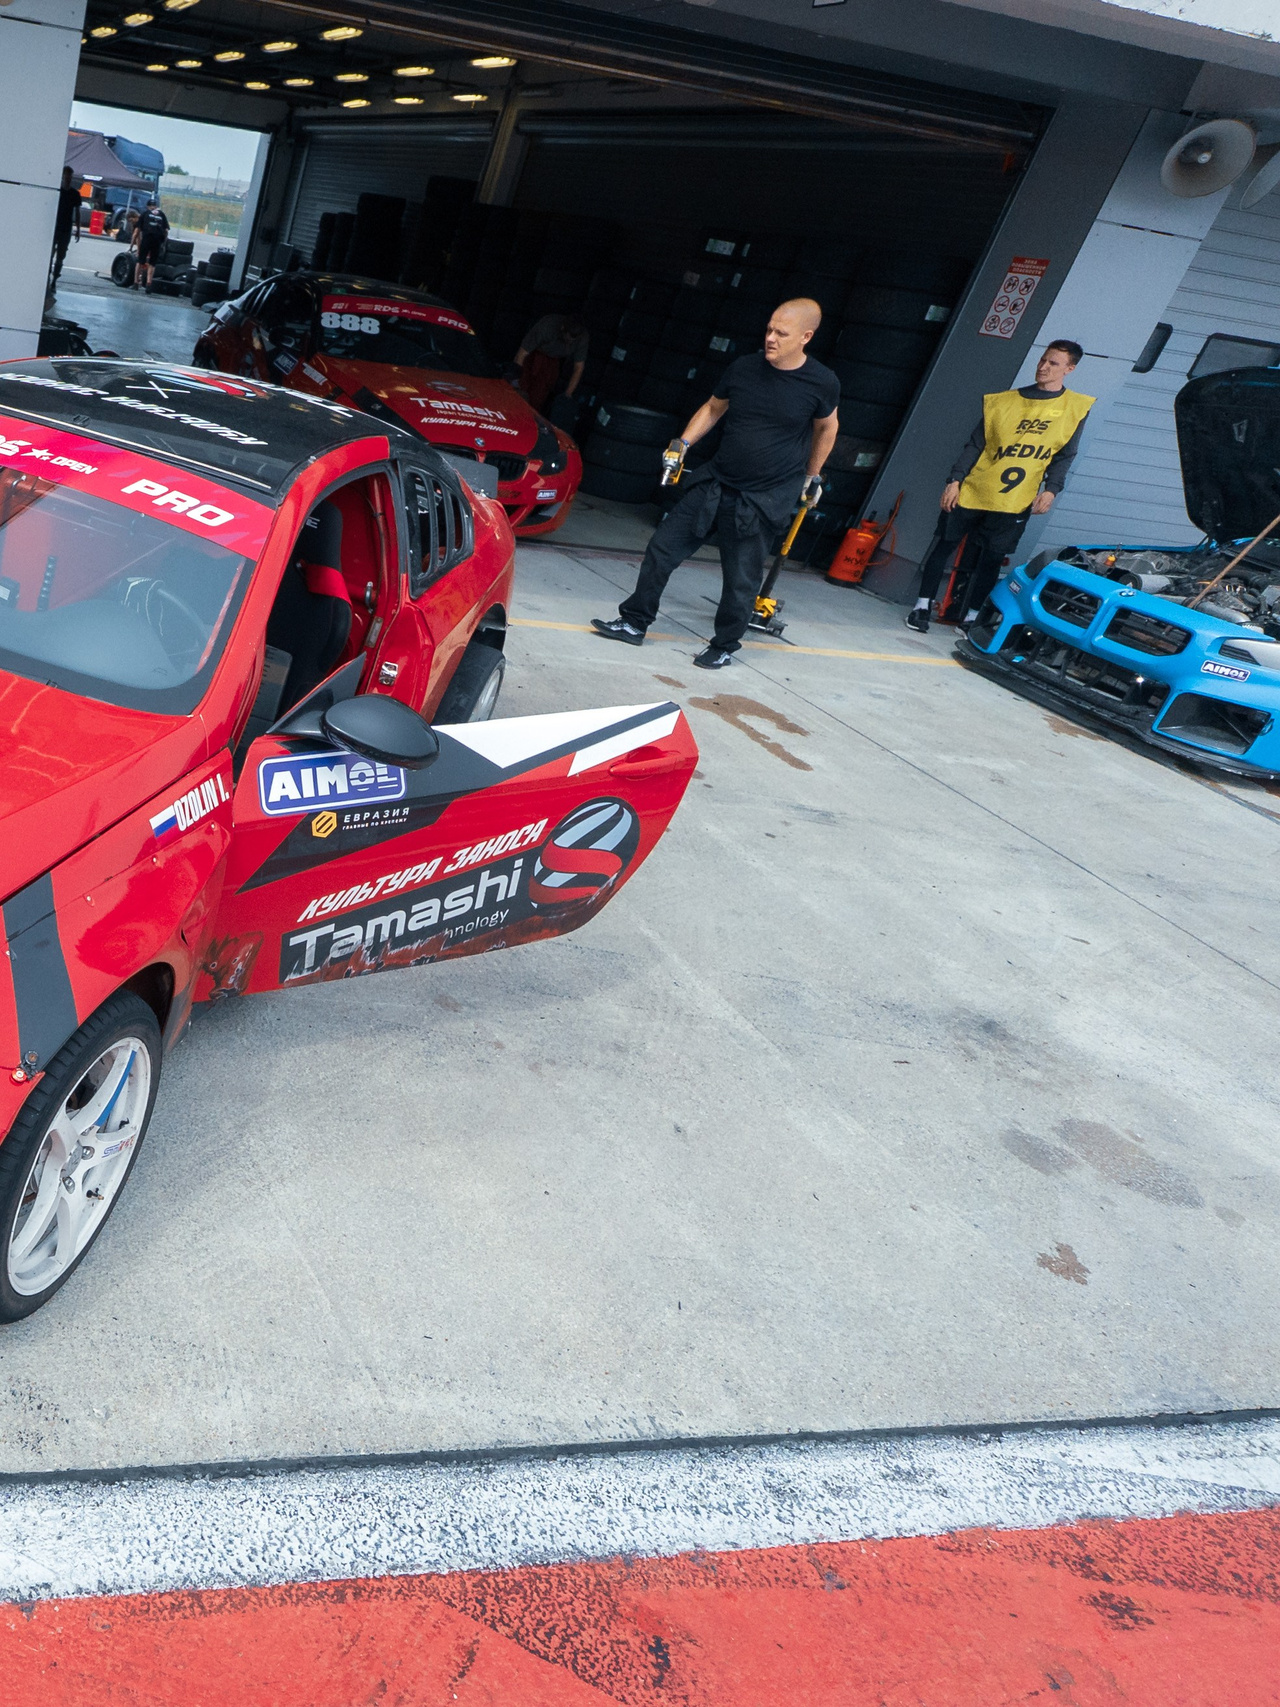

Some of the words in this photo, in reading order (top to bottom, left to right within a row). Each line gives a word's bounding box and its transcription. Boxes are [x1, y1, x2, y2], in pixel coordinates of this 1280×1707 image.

[321, 312, 380, 335] 888
[437, 315, 469, 330] PRO
[410, 397, 506, 421] Tamashi
[420, 416, 477, 428] КУЛЬТУРА
[478, 423, 519, 436] ЗАНОСА
[993, 443, 1052, 460] MEDIA
[50, 455, 98, 475] OPEN
[998, 466, 1026, 494] 9
[121, 478, 235, 528] PRO
[1204, 663, 1249, 681] AIMOL
[268, 761, 399, 803] AIMOL
[173, 777, 219, 832] OZOLIN
[343, 807, 410, 823] ЕВРАЗИЯ
[297, 857, 443, 923] КУЛЬТУРА
[445, 818, 549, 871] ЗАНОСА
[289, 858, 523, 969] Tamashi
[442, 908, 509, 939] hnology
